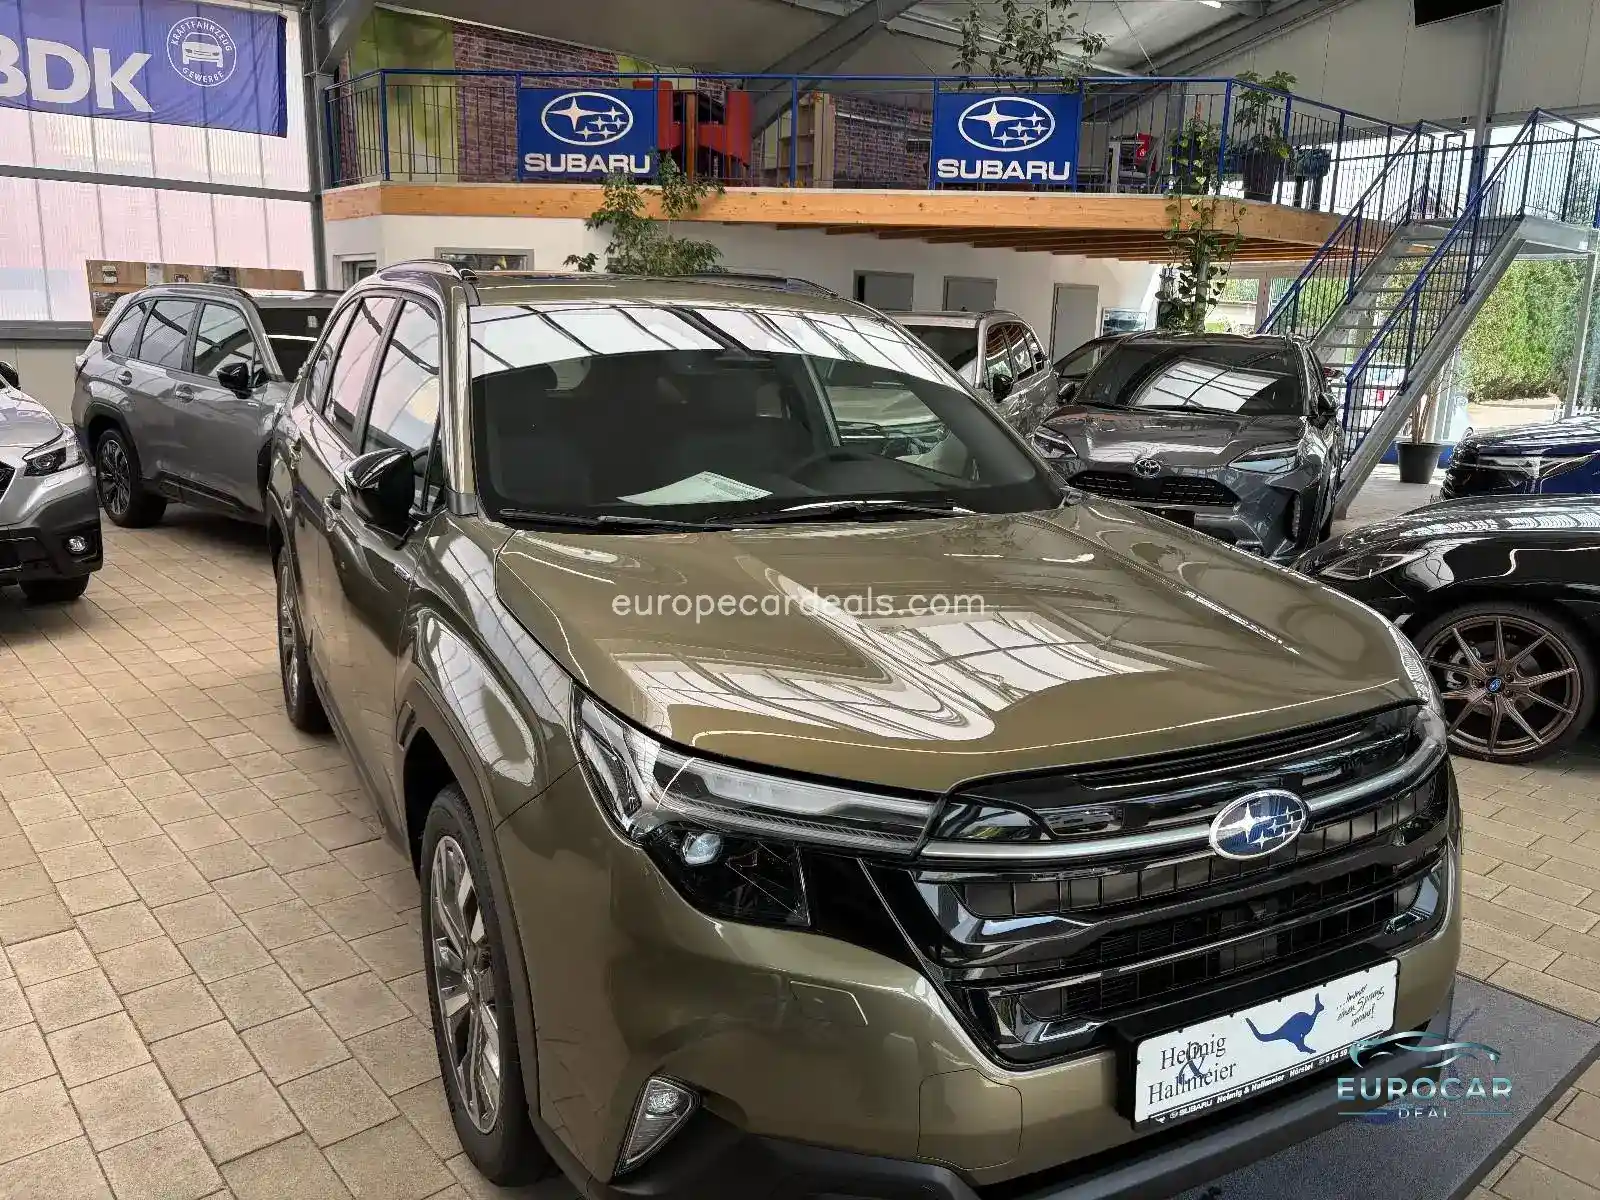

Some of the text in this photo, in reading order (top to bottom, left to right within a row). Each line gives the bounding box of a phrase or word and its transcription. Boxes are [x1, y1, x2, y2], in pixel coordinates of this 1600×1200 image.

[171, 21, 233, 52] KRAFTFAHRZEUG
[182, 67, 224, 83] GEWERBE
[524, 153, 651, 174] SUBARU
[937, 159, 1071, 181] SUBARU
[1160, 1034, 1227, 1071] Helmig
[1147, 1062, 1237, 1105] Hallmeier
[1179, 1100, 1213, 1116] SUBARU
[1217, 1089, 1244, 1104] Helmig
[1251, 1074, 1285, 1091] Hallmeier
